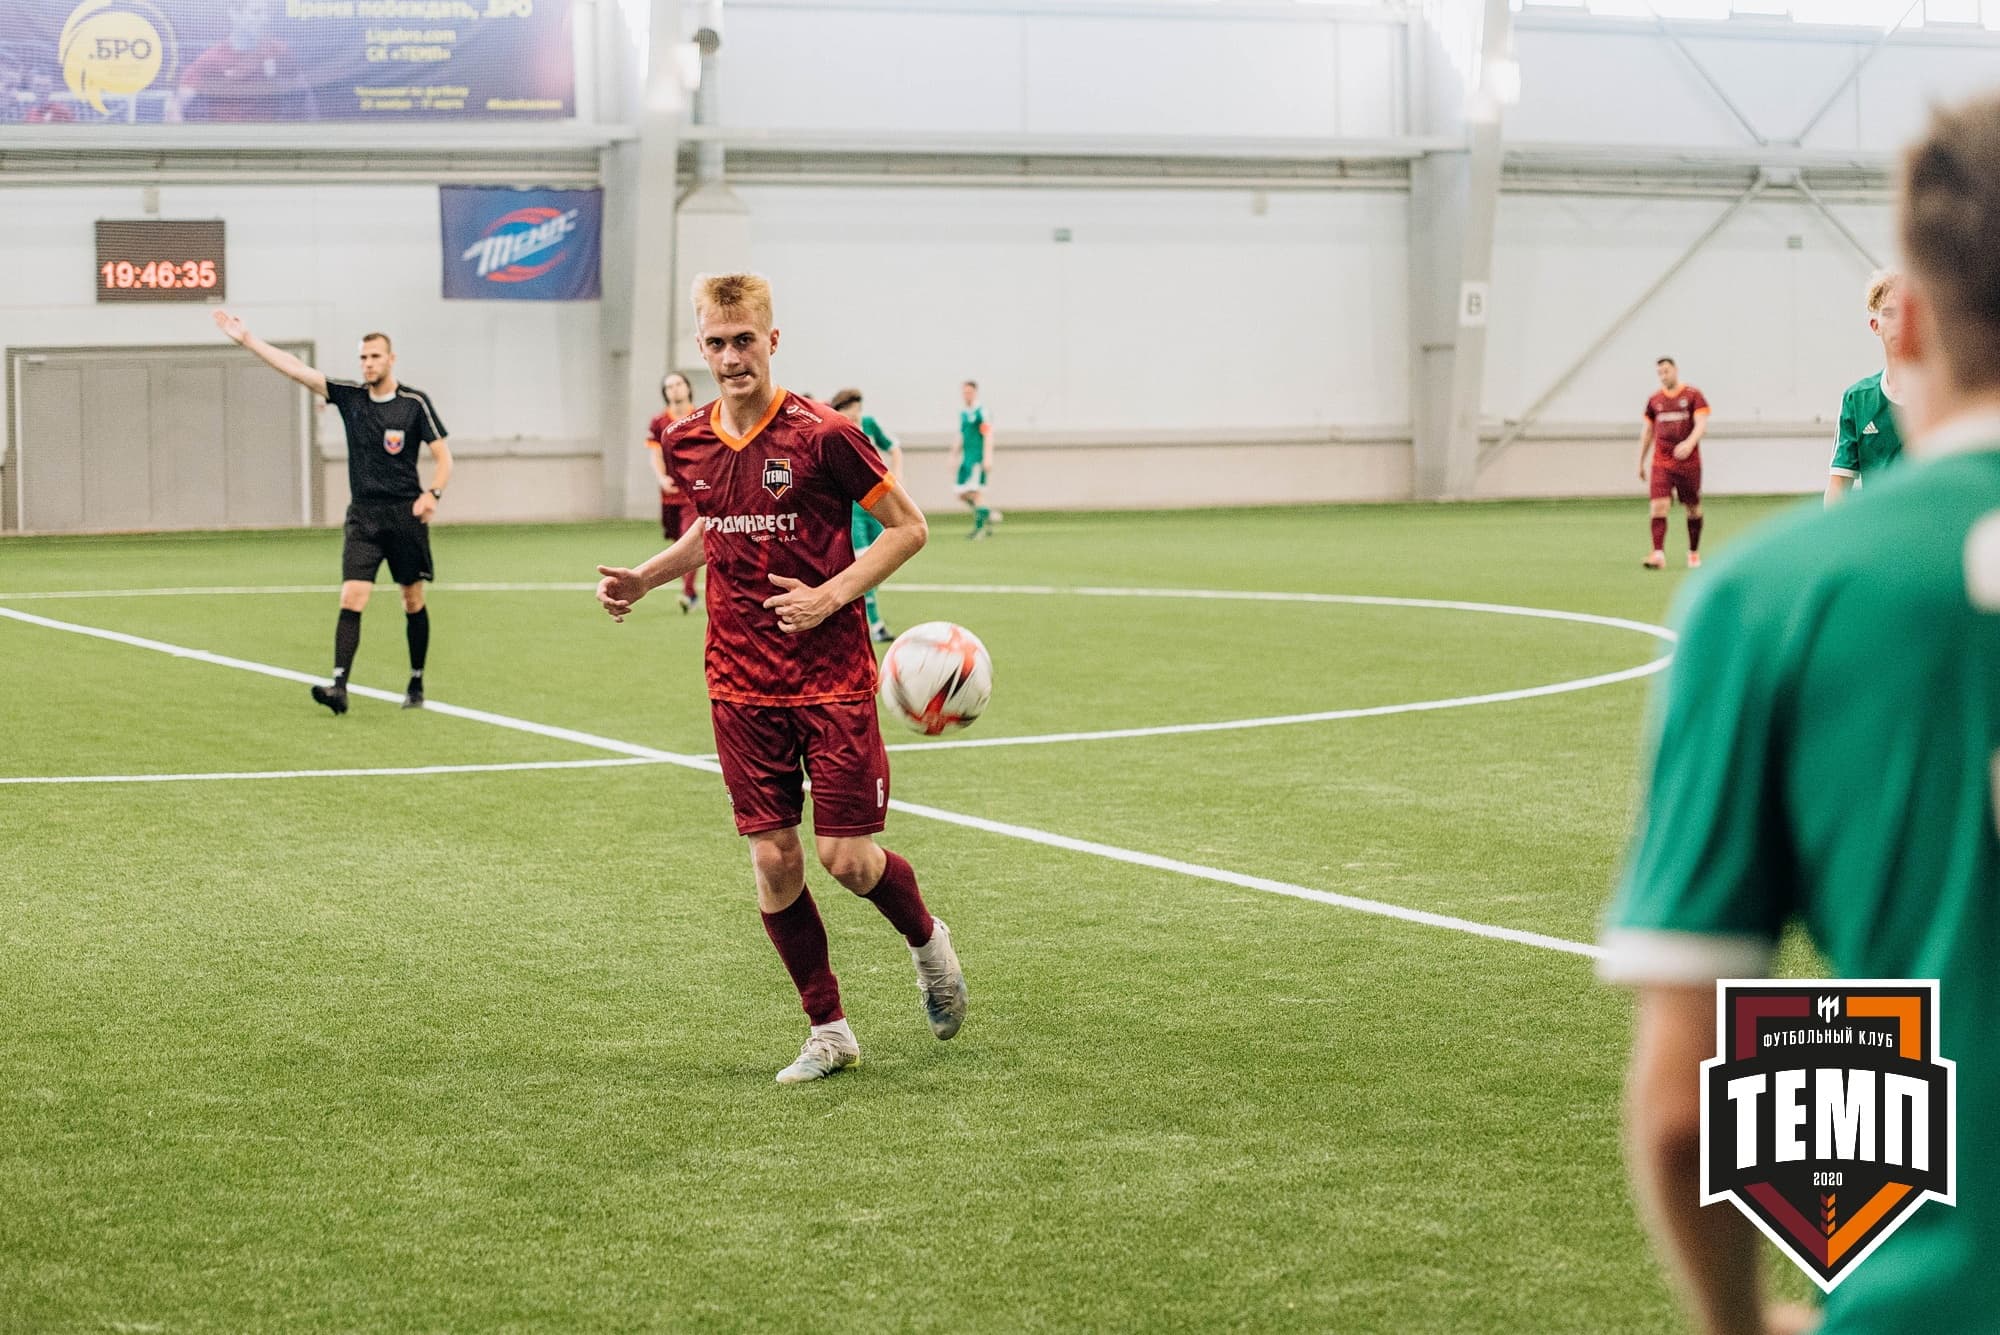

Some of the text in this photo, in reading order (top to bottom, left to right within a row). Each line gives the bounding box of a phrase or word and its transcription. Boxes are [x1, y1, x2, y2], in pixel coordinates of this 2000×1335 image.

[89, 38, 152, 59] .БРО
[101, 260, 217, 288] 19:46:35
[765, 470, 790, 484] ТЕМП
[876, 777, 884, 808] 6
